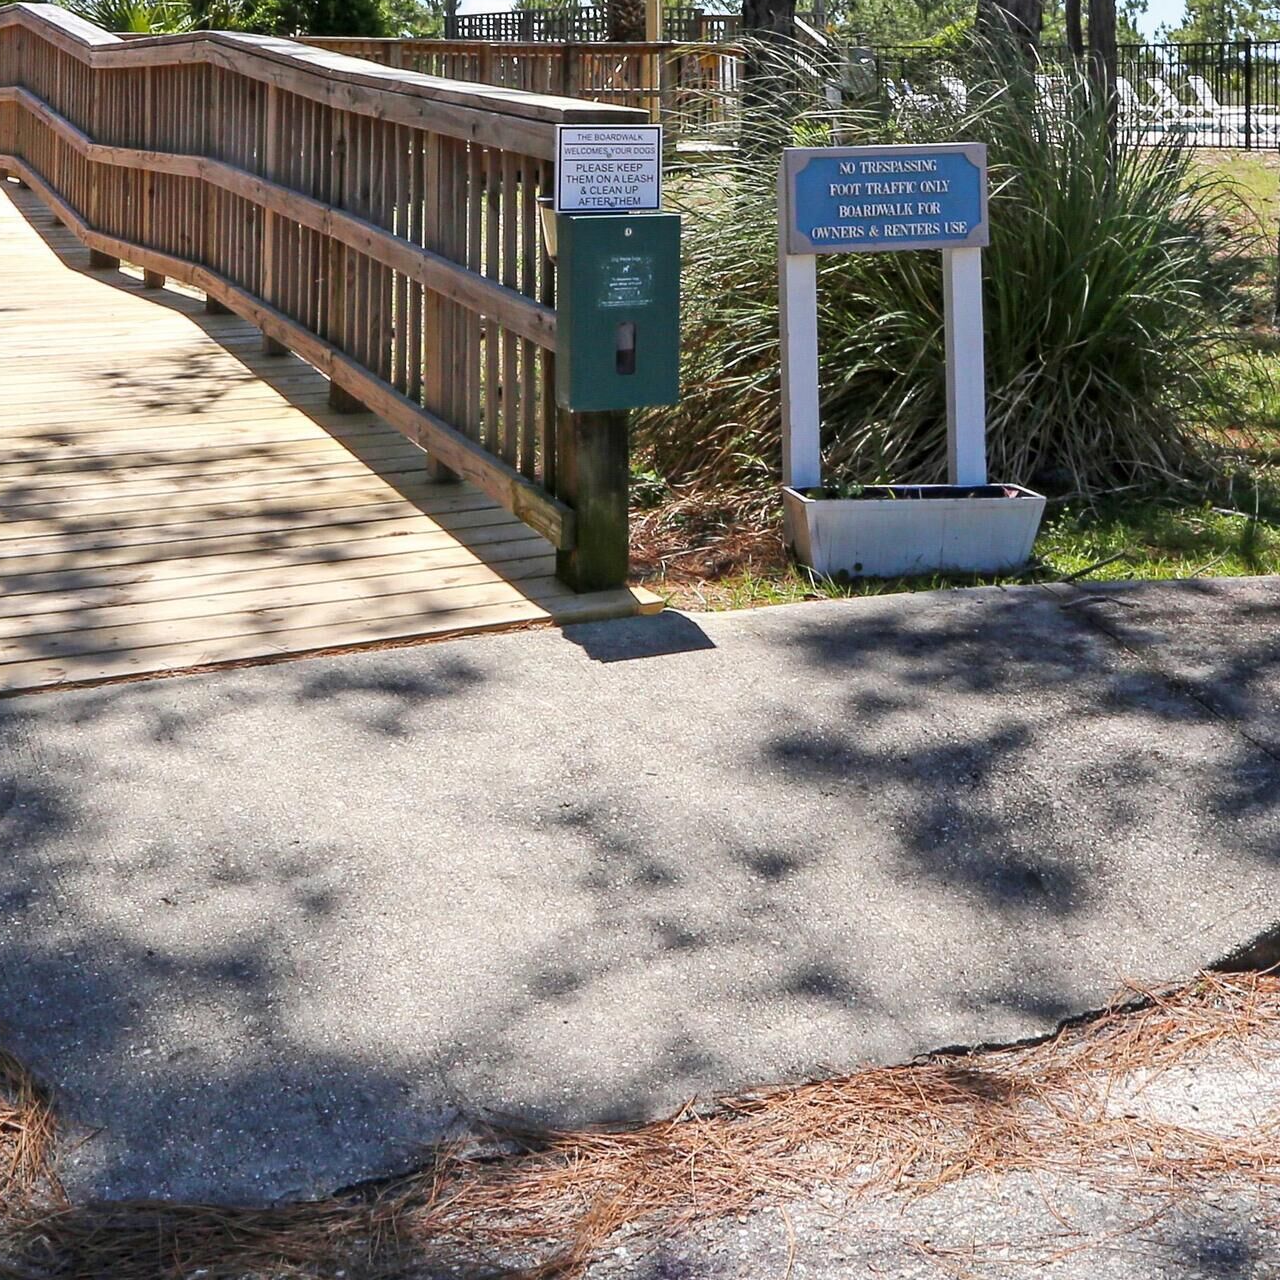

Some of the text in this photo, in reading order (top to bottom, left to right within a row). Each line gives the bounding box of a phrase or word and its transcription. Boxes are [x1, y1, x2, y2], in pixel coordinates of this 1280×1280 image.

[576, 163, 643, 172] PLEASE KEEP
[839, 160, 937, 175] NO TRESPASSING
[567, 175, 594, 183] THEM
[596, 175, 611, 183] ON
[613, 175, 621, 183] A
[580, 186, 587, 194] &
[590, 186, 622, 194] CLEAN
[829, 180, 950, 196] FOOT TRAFFIC ONLY
[578, 197, 641, 206] AFTER THEM
[839, 202, 940, 218] BOARDWALK FOR
[811, 222, 967, 239] OWNERS & RENTERS USE
